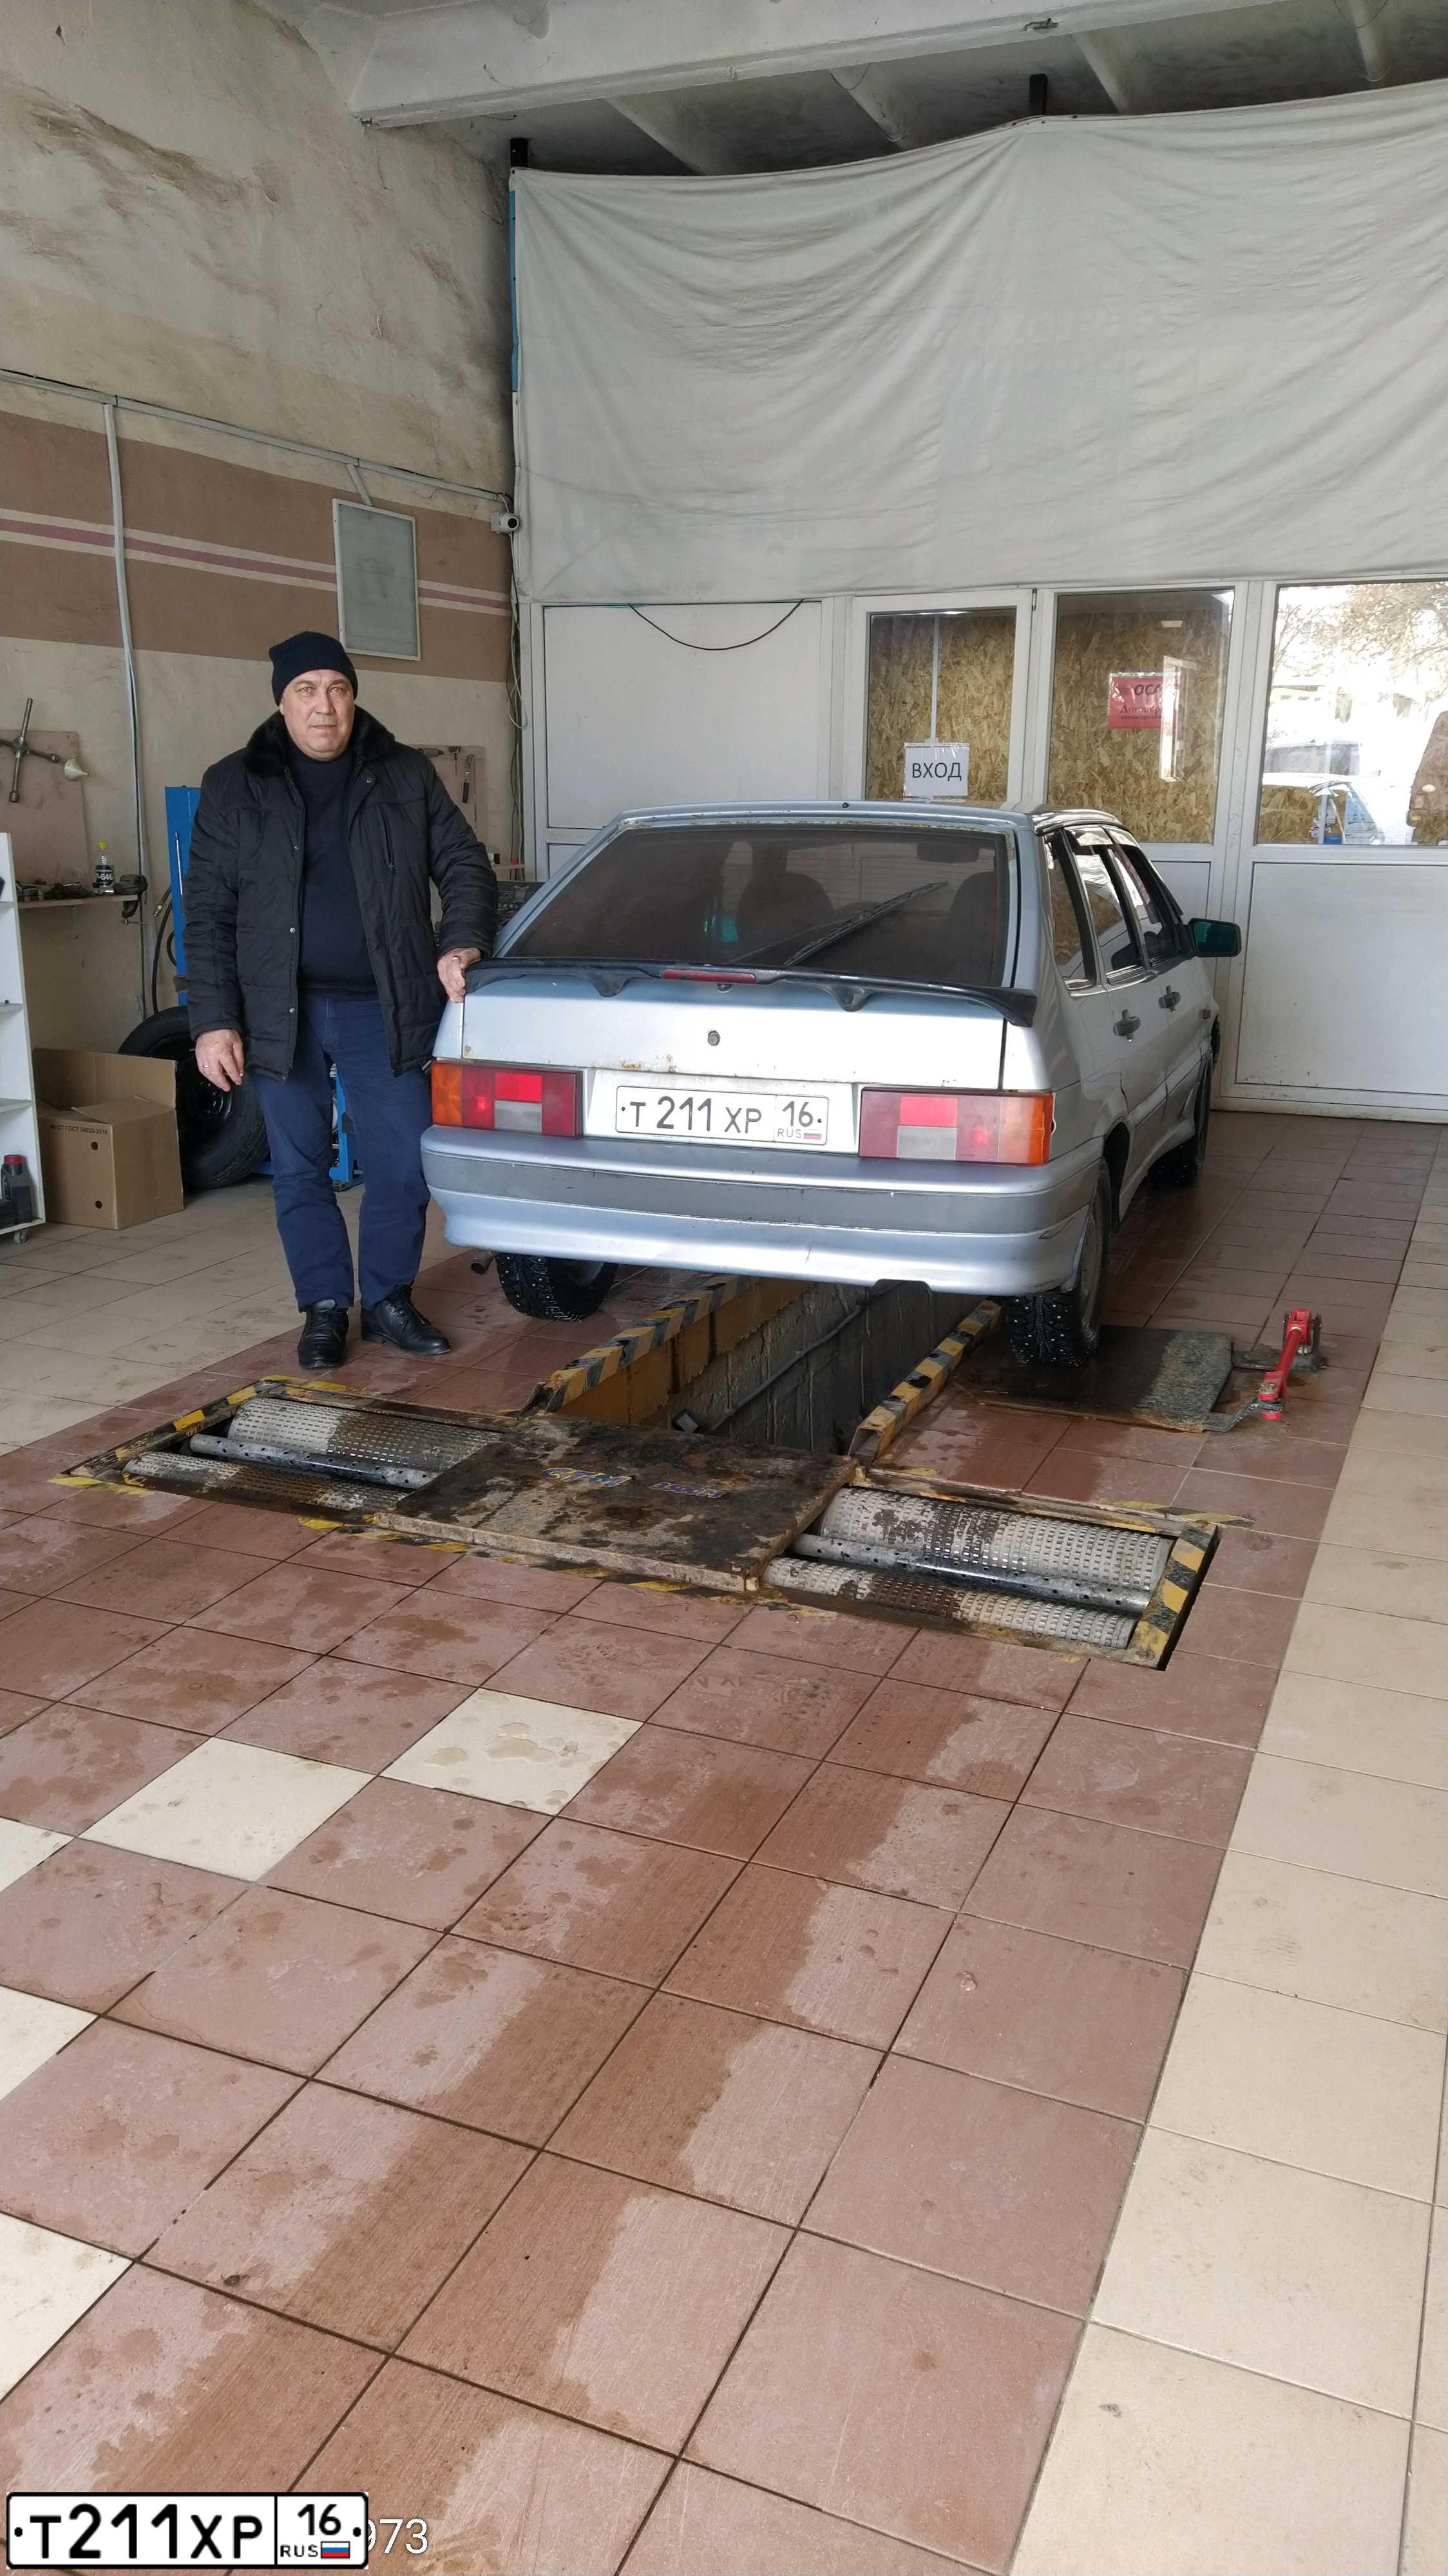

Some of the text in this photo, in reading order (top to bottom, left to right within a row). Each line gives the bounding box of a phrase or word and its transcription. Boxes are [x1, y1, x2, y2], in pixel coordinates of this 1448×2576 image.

[912, 762, 962, 782] ВХОД
[782, 1101, 814, 1128] 16
[777, 1128, 803, 1139] RUS
